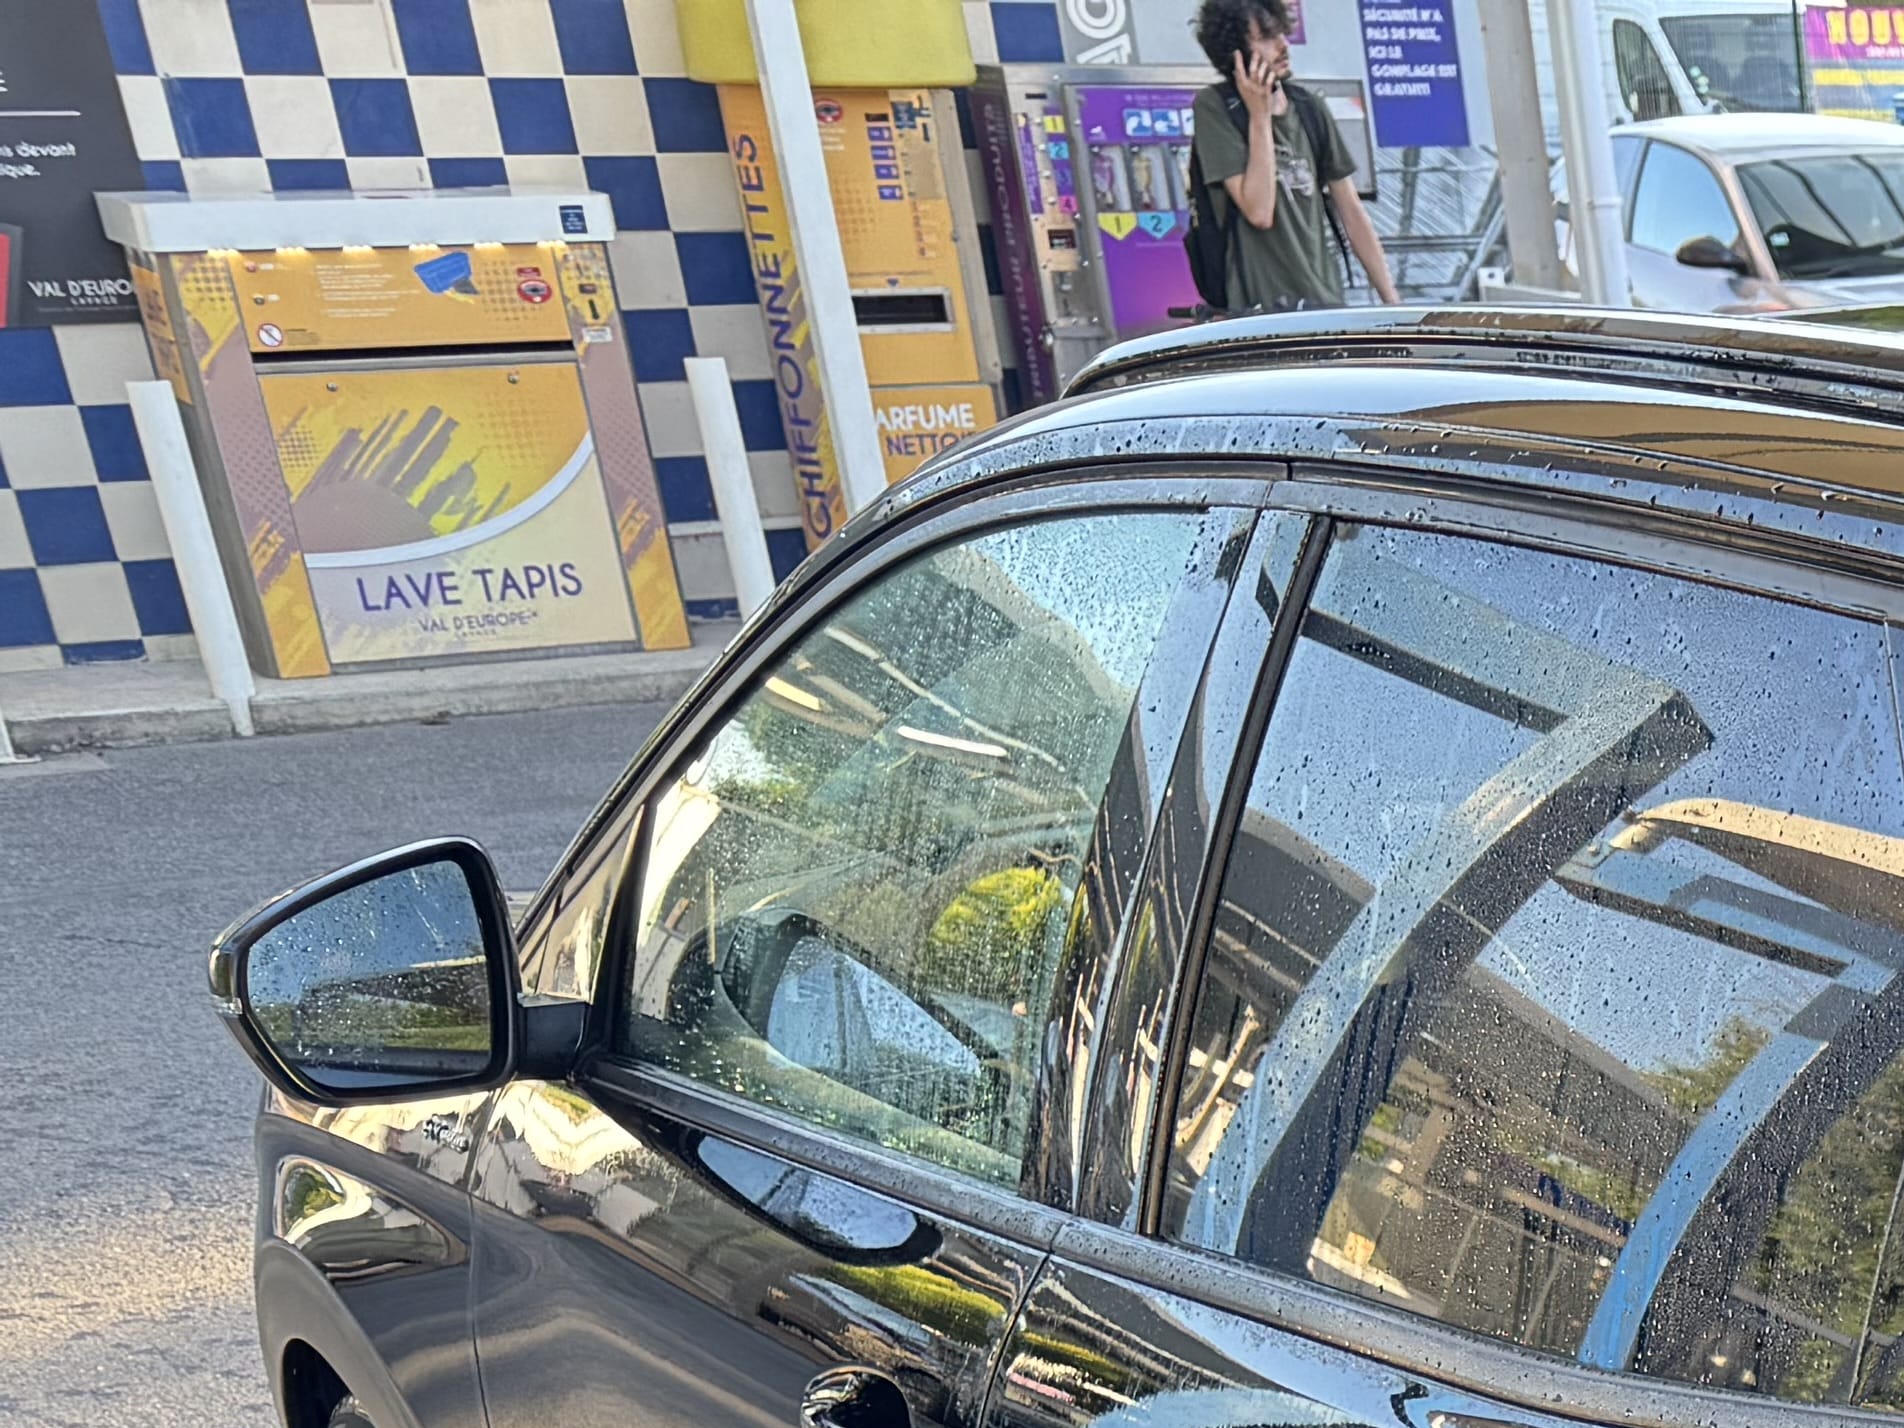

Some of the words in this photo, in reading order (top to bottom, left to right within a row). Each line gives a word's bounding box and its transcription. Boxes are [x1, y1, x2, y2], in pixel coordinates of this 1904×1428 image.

[1114, 214, 1122, 233] 1
[1151, 214, 1163, 233] 2
[27, 280, 66, 297] VAL
[67, 278, 133, 296] D'EURO
[731, 133, 832, 538] CHIFFONNETTES
[875, 402, 976, 431] ARFUME
[356, 571, 463, 612] LAVE
[472, 562, 583, 602] TAPIS
[418, 617, 450, 632] VAL
